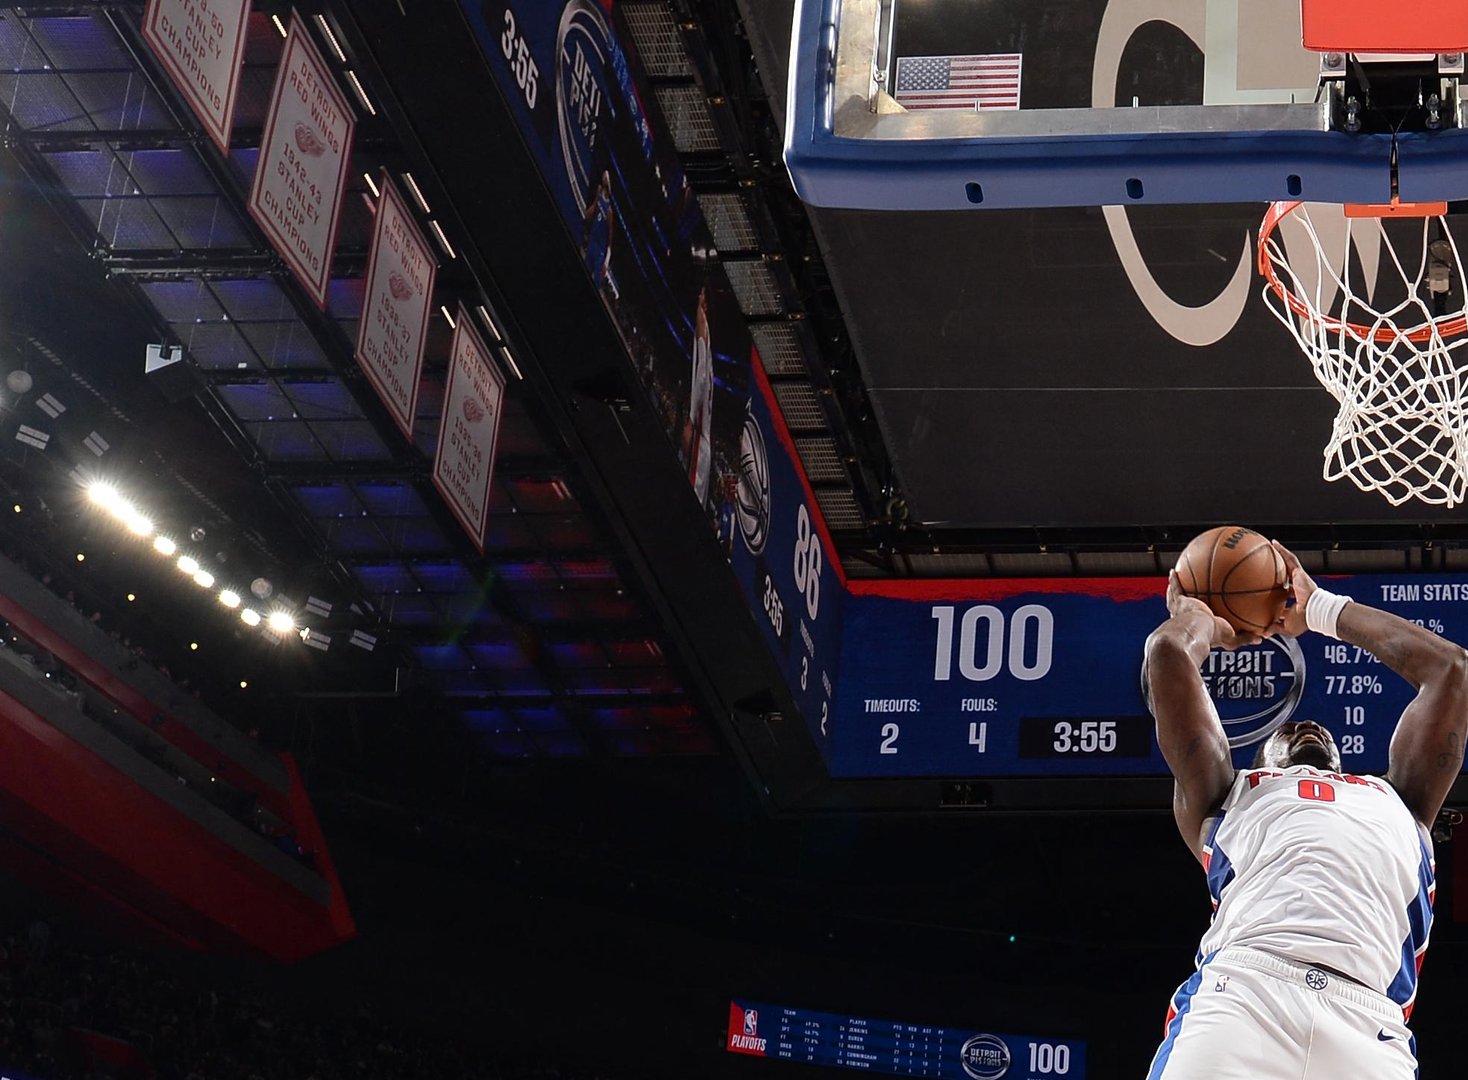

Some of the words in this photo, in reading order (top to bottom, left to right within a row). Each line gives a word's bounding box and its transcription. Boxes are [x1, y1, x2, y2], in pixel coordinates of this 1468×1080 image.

[185, 26, 207, 58] CUP
[161, 16, 220, 111] CHAMPIONS
[502, 9, 539, 109] 3:55
[302, 62, 338, 125] DETROIT
[290, 71, 309, 103] RED
[311, 103, 339, 154] WINGS
[278, 161, 320, 225] STANLEY
[286, 196, 305, 225] CUP
[264, 190, 319, 272] CHAMPIONS
[367, 338, 408, 408] CHAMPIONS
[794, 504, 822, 620] 86
[764, 575, 783, 637] 3:55
[1381, 585, 1420, 602] TEAM
[930, 604, 1054, 682] 100
[1325, 645, 1381, 664] 46.7%
[1325, 675, 1382, 694] 77.8%
[864, 697, 921, 713] TIMEOUTS:
[960, 697, 998, 713] FOULS:
[1344, 706, 1365, 725] 10
[880, 723, 899, 755] 2
[967, 722, 988, 754] 4
[1052, 720, 1118, 754] 3:55
[1341, 735, 1365, 754] 28
[731, 1034, 767, 1052] PLAYOFFS
[1028, 1042, 1070, 1075] 100
